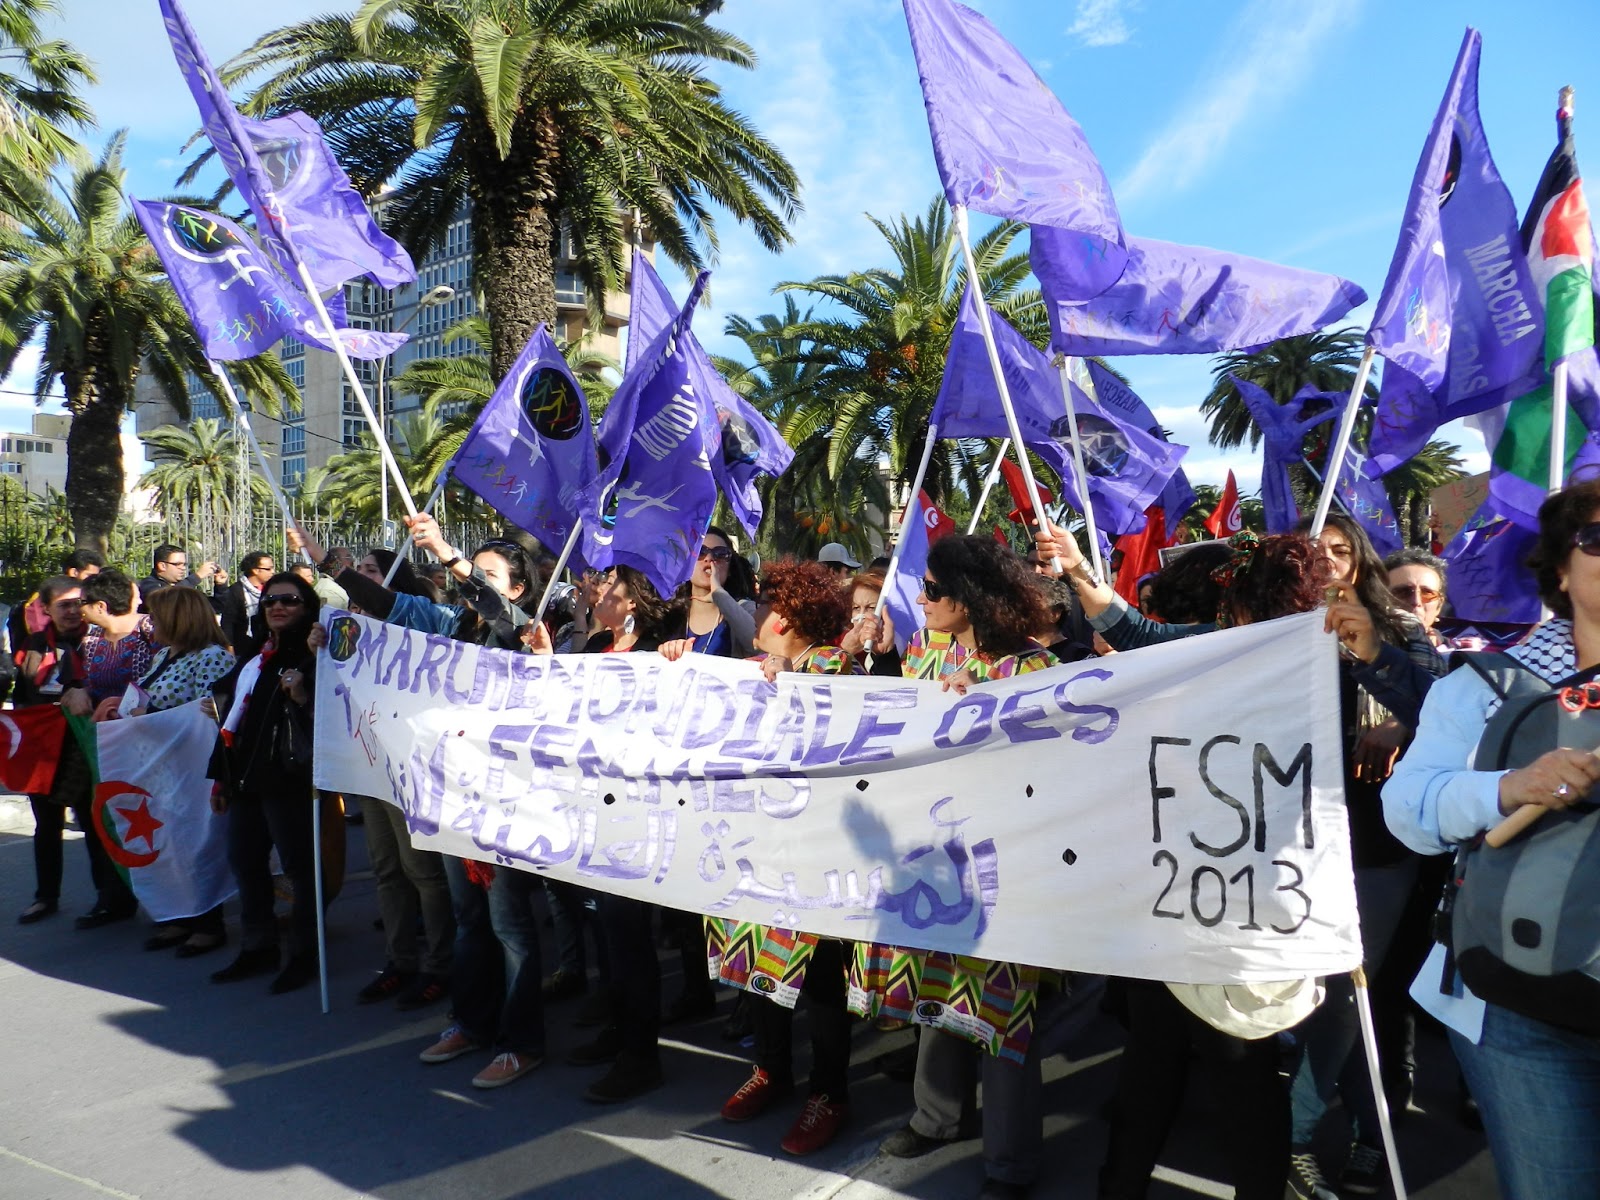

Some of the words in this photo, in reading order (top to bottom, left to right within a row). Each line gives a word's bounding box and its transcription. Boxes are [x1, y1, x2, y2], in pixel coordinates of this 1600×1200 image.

[1463, 234, 1537, 348] MARCHA
[352, 619, 544, 711] MARCHE
[534, 656, 918, 768] MONDIALE
[488, 724, 812, 819] FEMMES
[1147, 734, 1314, 857] FSM
[1152, 849, 1311, 934] 2013
